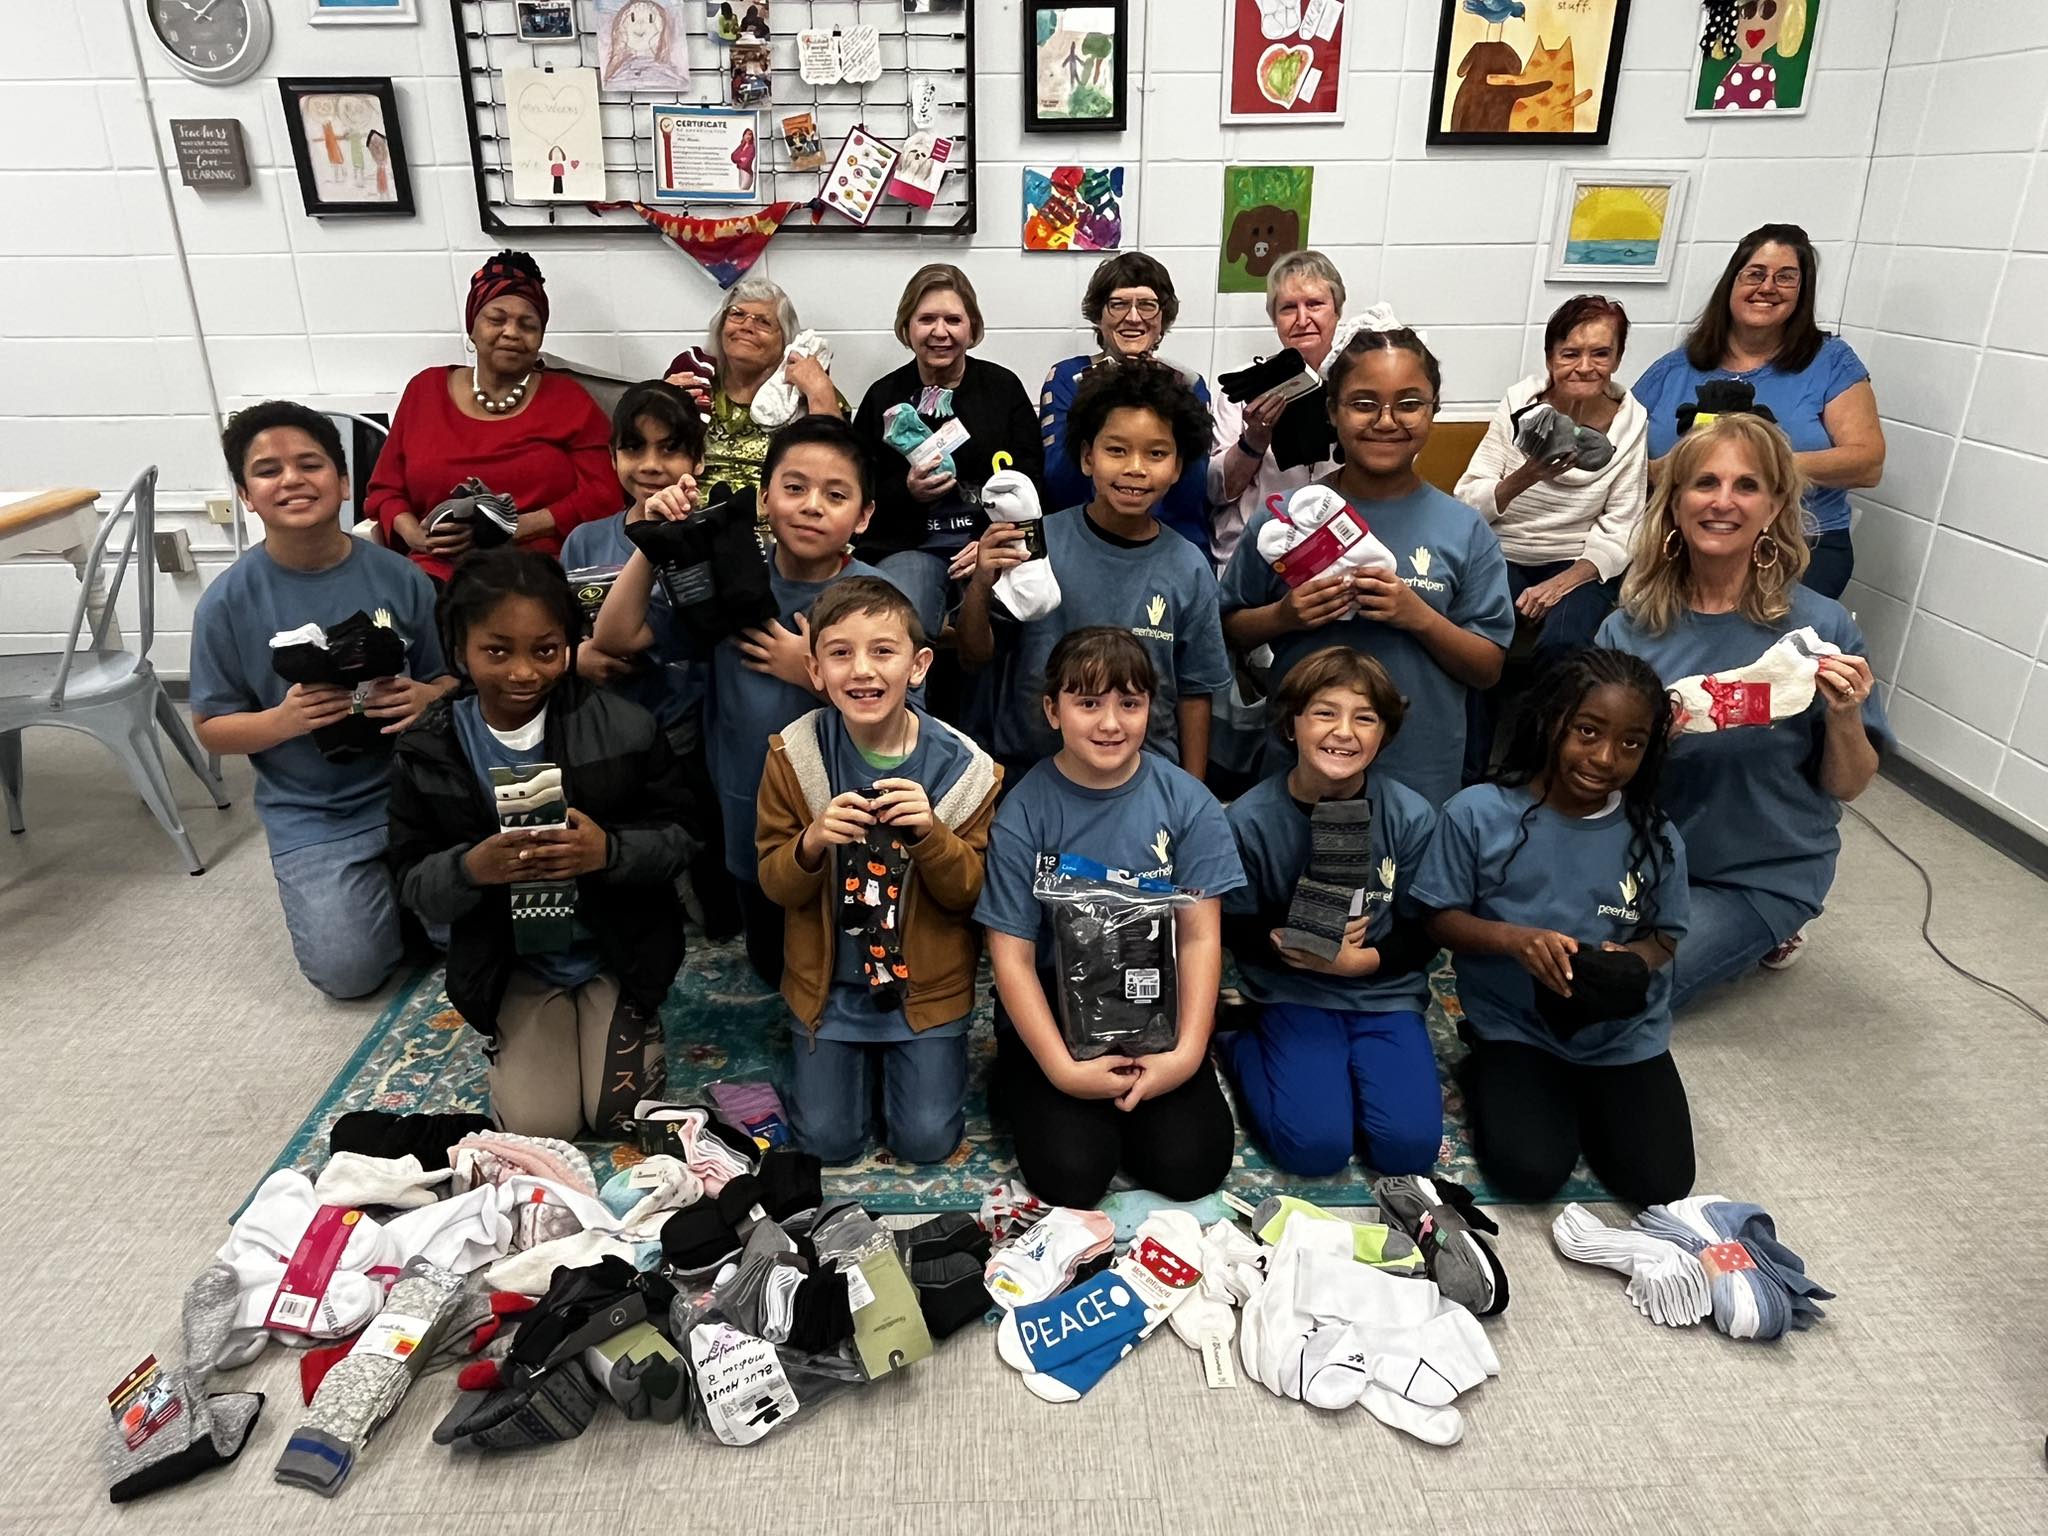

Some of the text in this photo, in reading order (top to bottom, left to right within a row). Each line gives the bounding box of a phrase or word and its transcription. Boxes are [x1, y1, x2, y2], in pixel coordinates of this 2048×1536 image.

[190, 45, 196, 56] 7
[226, 43, 234, 54] 5
[208, 49, 216, 61] 6
[676, 120, 727, 129] CERTIFICATE
[187, 169, 236, 181] LEARNING
[950, 515, 973, 530] THE
[1400, 576, 1446, 592] erhelpers
[1043, 856, 1056, 866] 12
[1020, 1288, 1117, 1354] PEACE
